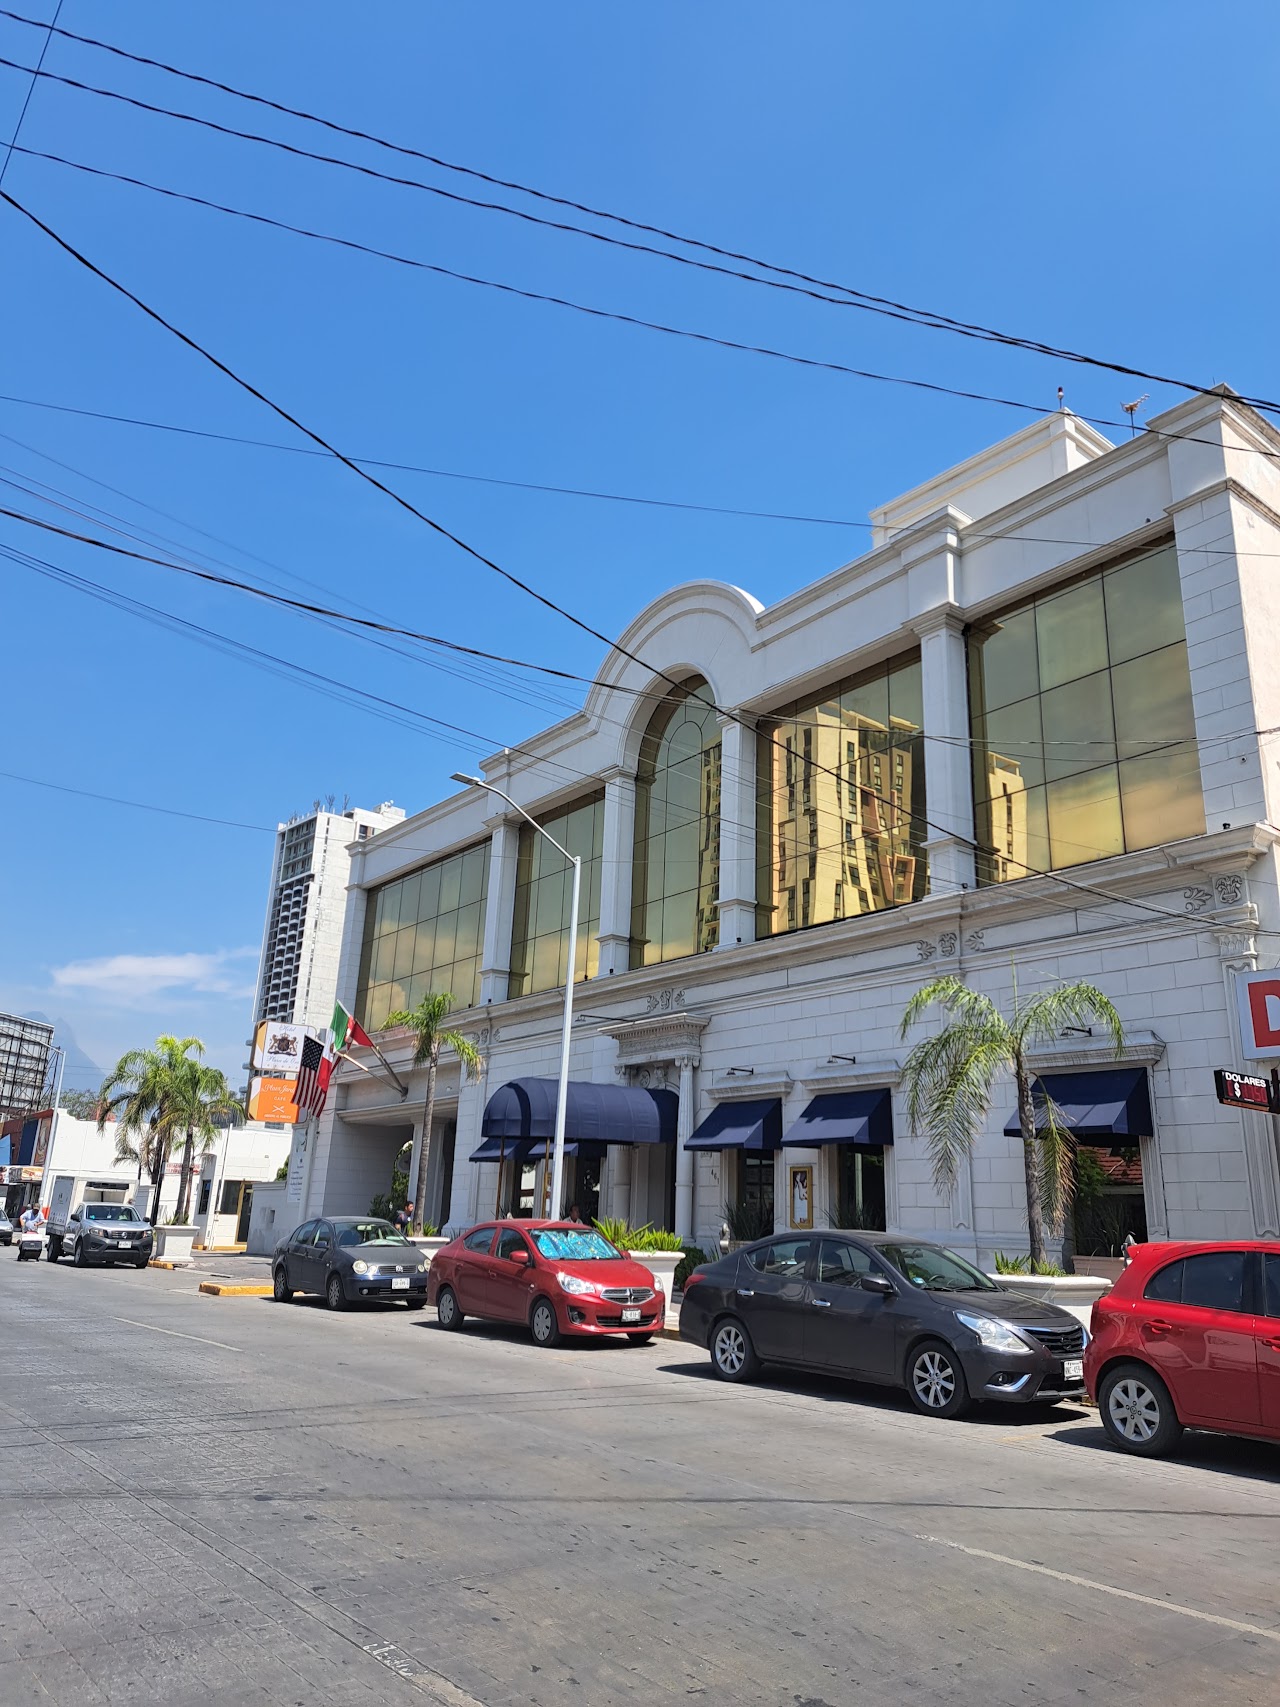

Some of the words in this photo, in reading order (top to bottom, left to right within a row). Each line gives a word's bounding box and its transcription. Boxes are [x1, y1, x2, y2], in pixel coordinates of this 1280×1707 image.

[279, 1024, 297, 1032] Hotel
[1225, 1072, 1266, 1087] DOLARES
[280, 1086, 295, 1094] Jard
[1234, 1082, 1241, 1098] $
